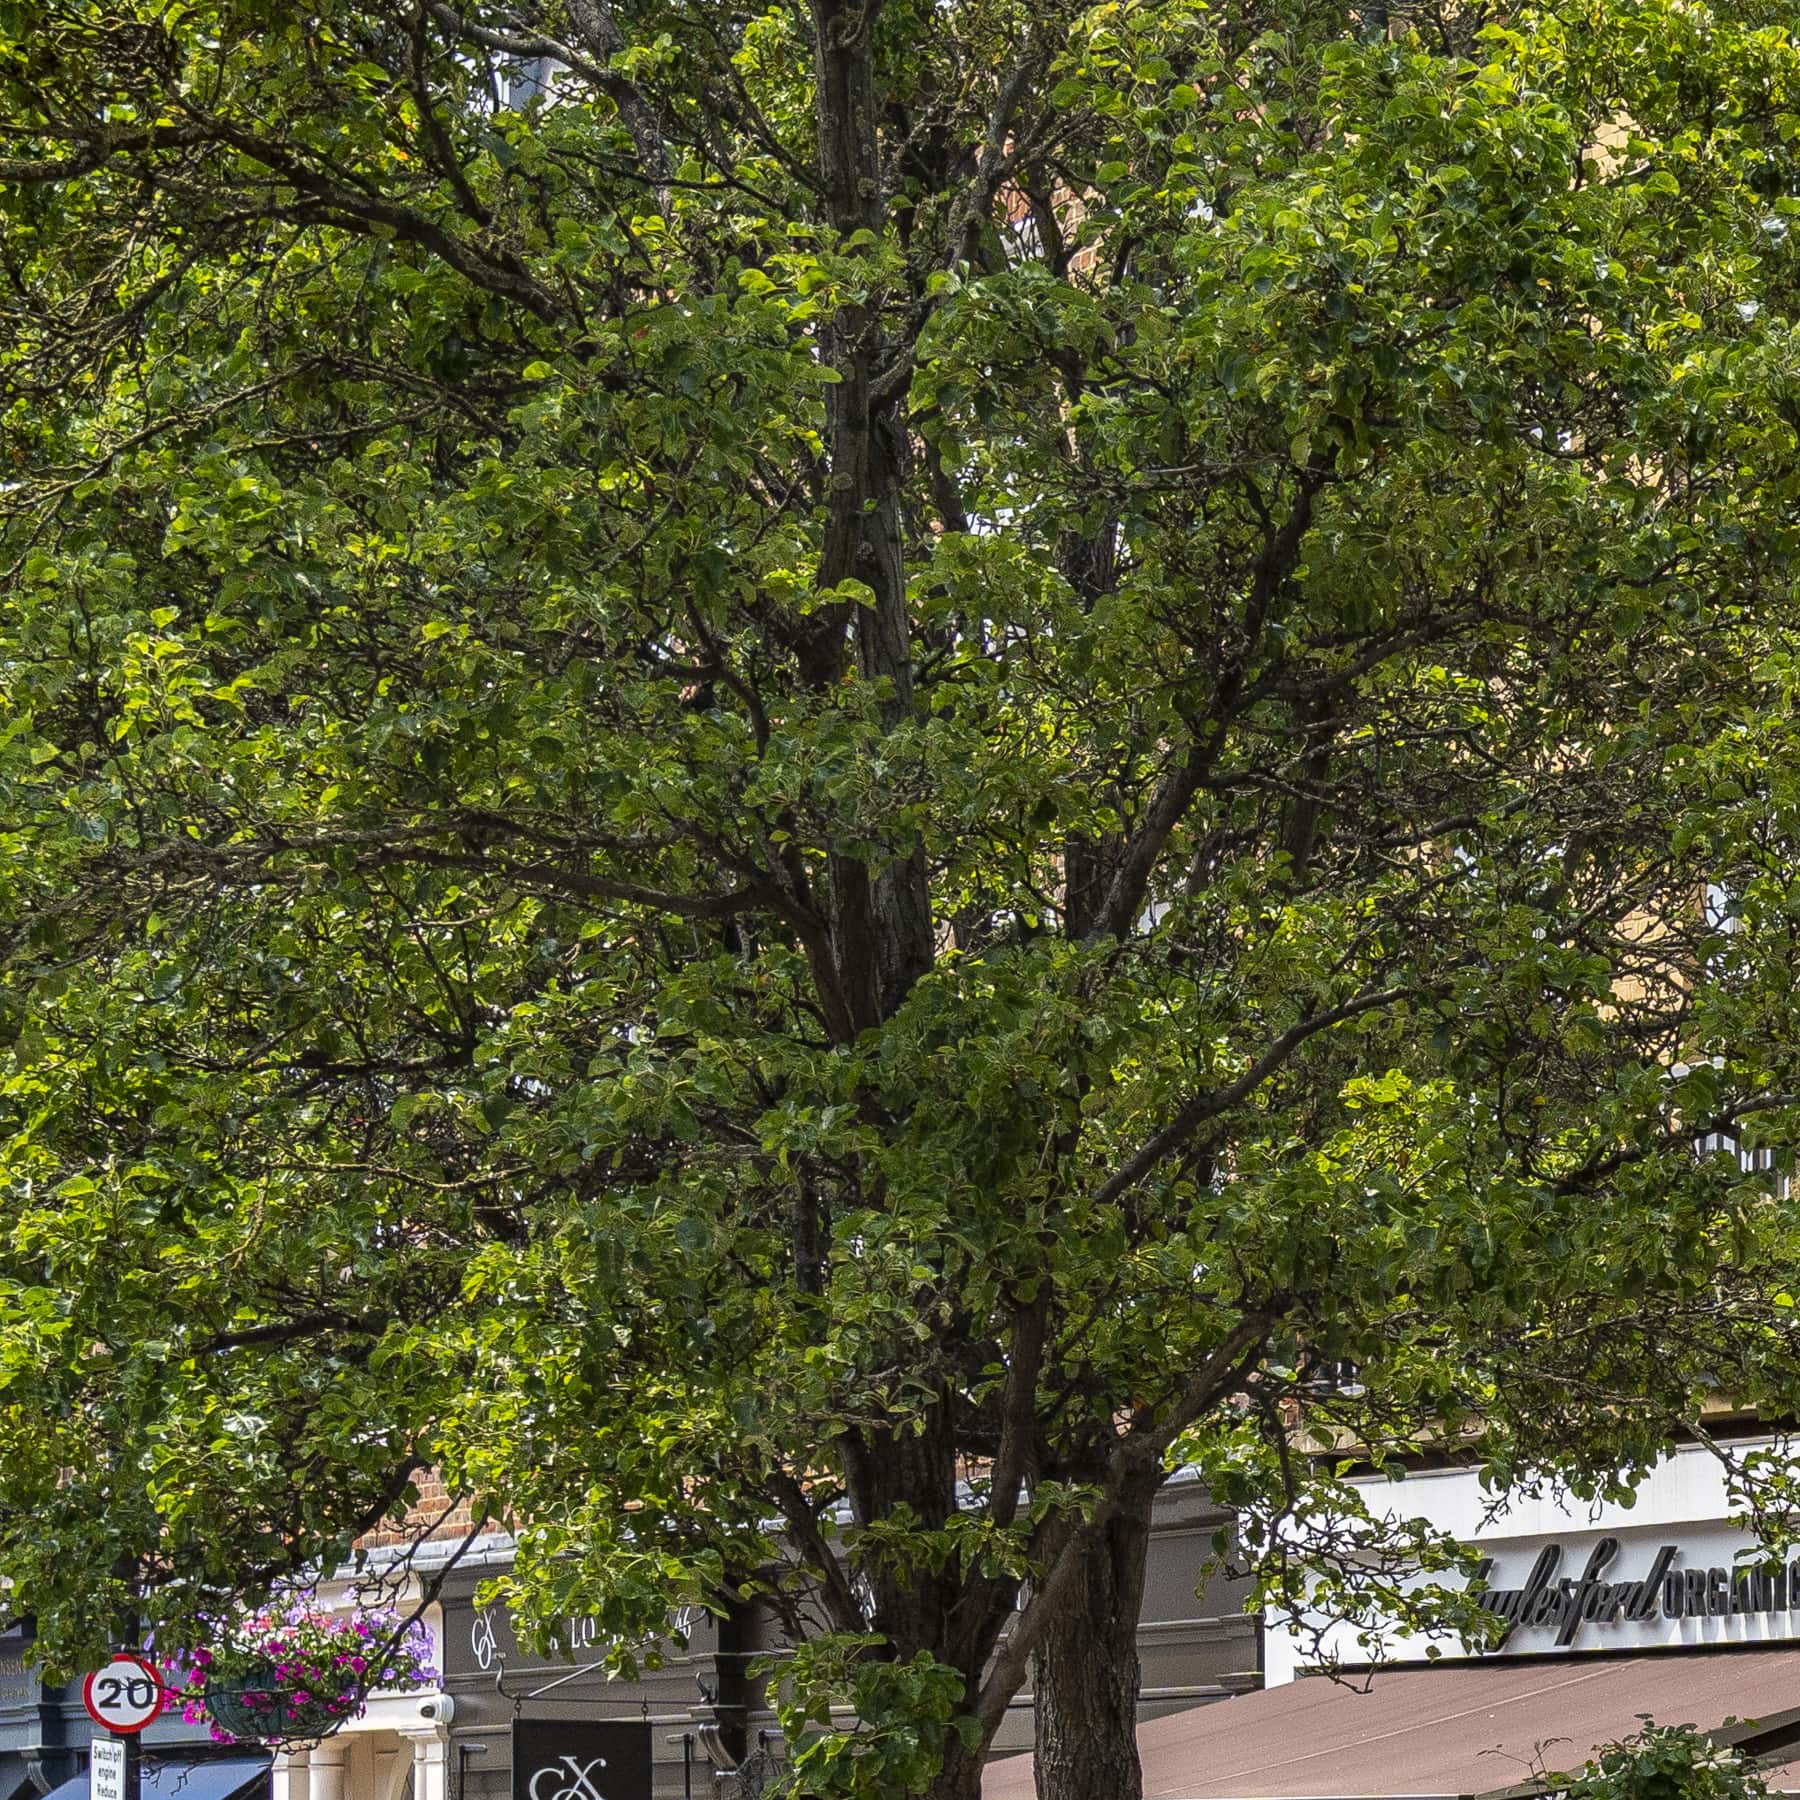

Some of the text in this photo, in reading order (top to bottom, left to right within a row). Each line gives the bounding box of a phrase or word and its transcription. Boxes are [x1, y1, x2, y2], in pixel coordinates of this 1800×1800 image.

[1464, 1537, 1677, 1653] ylesford
[98, 1678, 154, 1709] 20
[93, 1745, 122, 1762] Switch off
[98, 1765, 116, 1781] engine
[97, 1783, 117, 1799] Reduce
